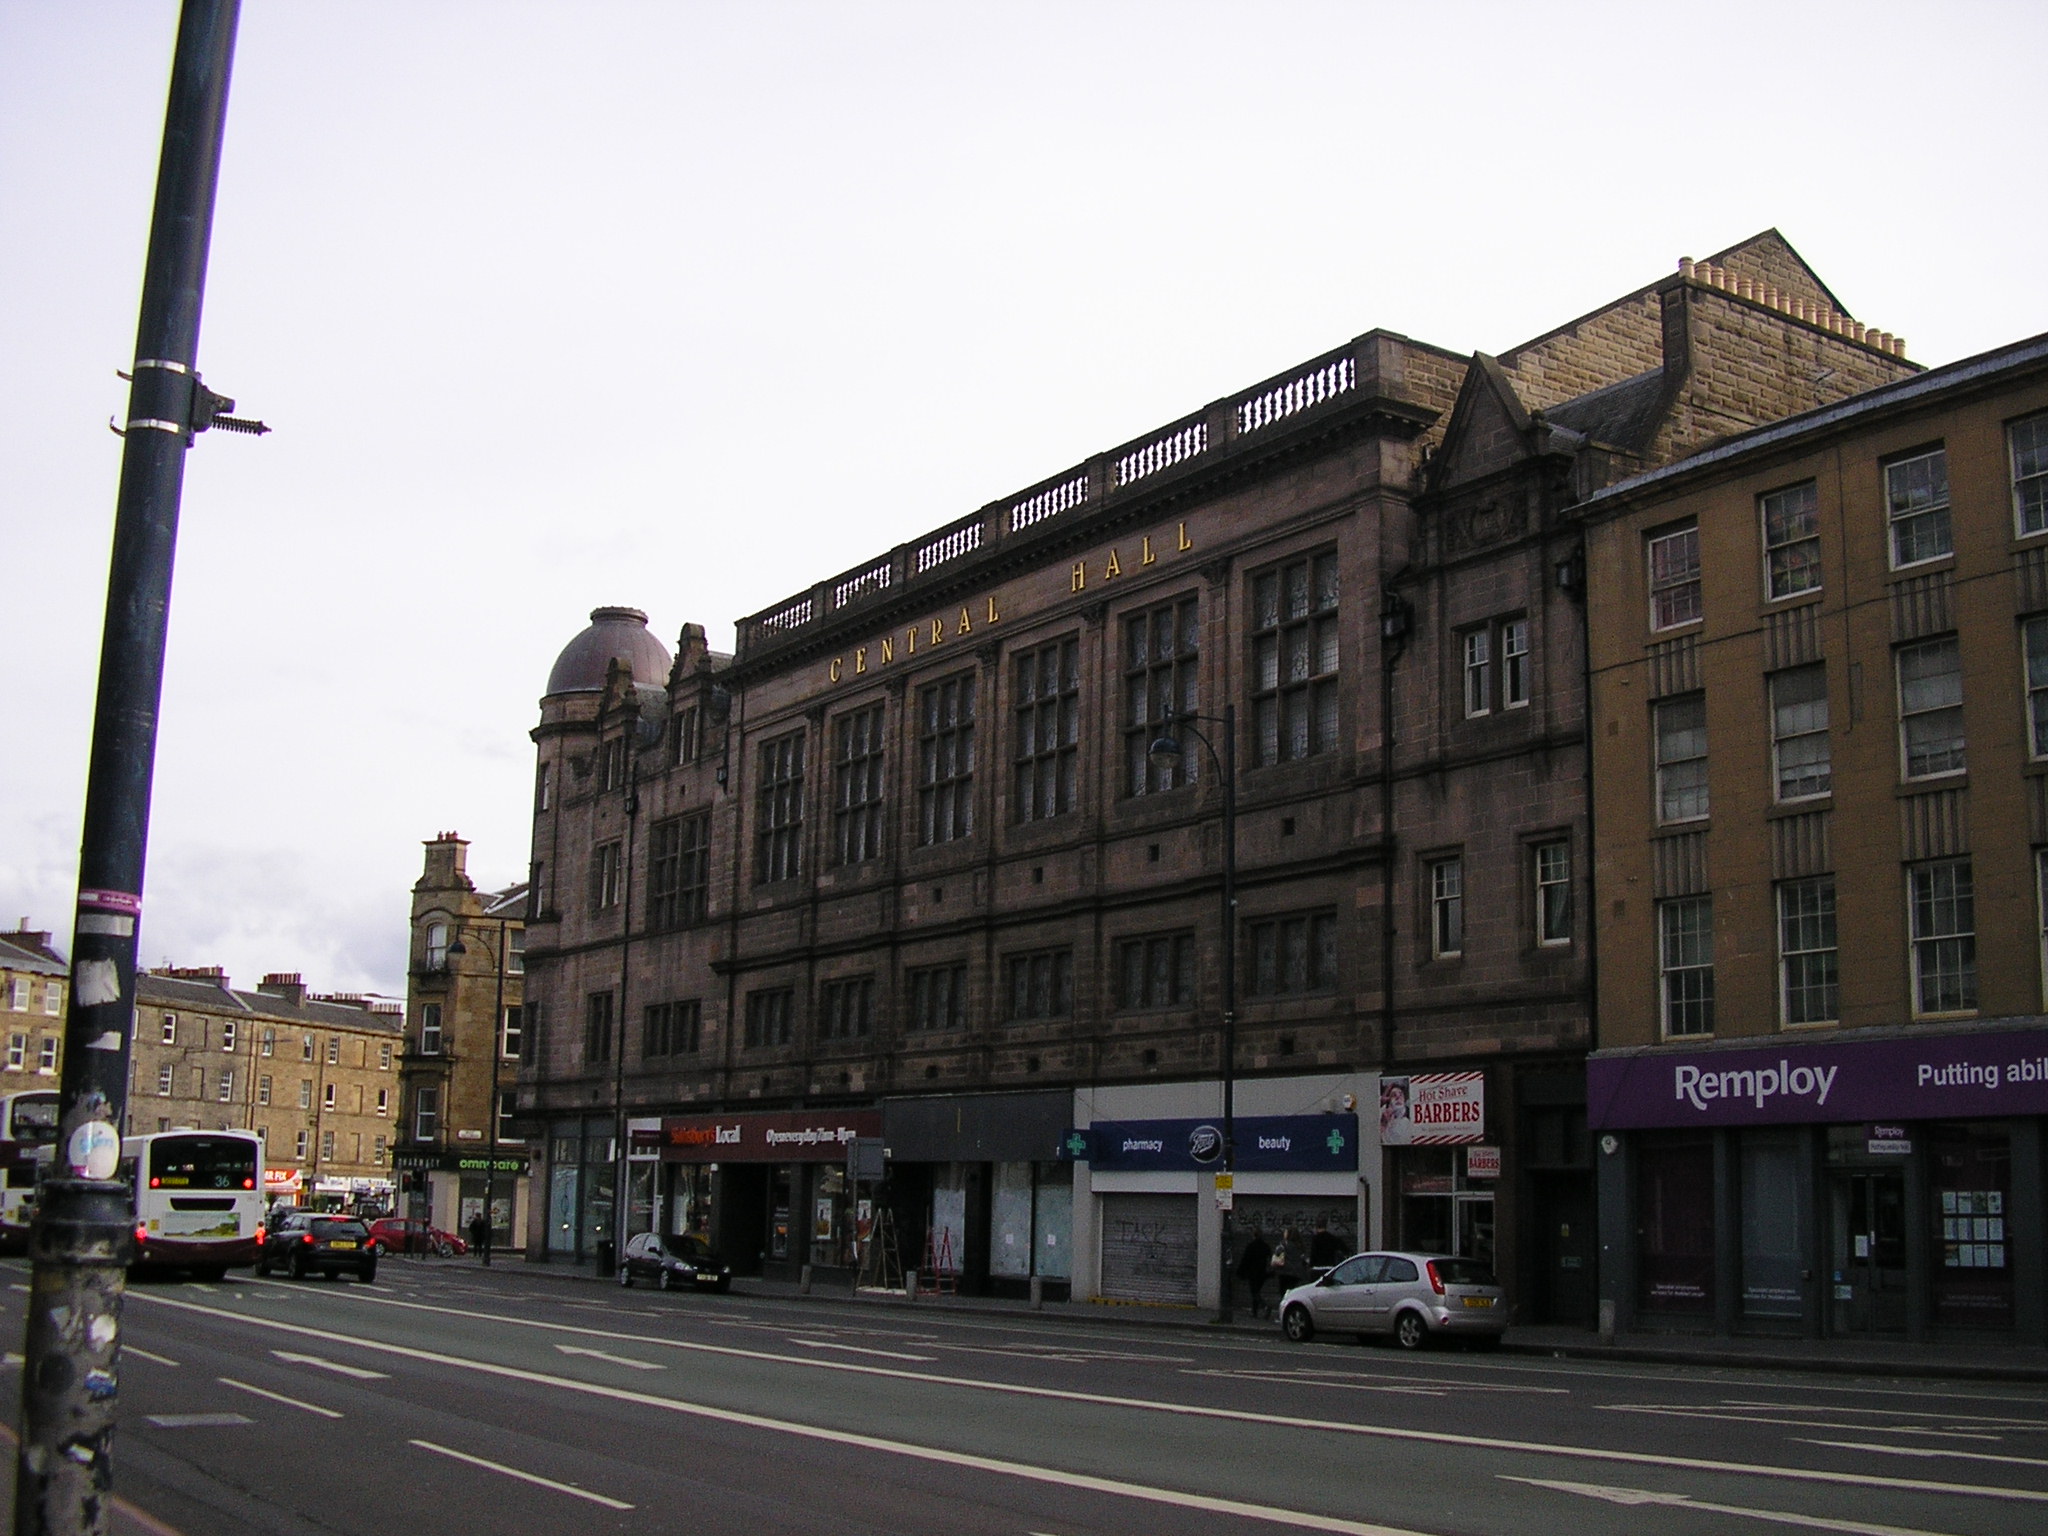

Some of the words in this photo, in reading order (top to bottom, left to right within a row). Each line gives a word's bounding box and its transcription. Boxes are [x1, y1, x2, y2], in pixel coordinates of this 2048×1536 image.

[829, 596, 1000, 682] CENTRAL
[1070, 522, 1193, 593] HALL
[1917, 1061, 1999, 1089] Putting
[1675, 1060, 1838, 1110] Remploy
[1419, 1090, 1436, 1102] Hot
[1438, 1086, 1468, 1100] Shave
[1413, 1101, 1480, 1124] BARBERS
[716, 1124, 741, 1144] Local
[1874, 1125, 1905, 1138] Remploy
[1122, 1138, 1163, 1152] pharmacy
[1258, 1136, 1291, 1151] beauty
[459, 1159, 519, 1170] omnare
[1469, 1157, 1499, 1169] BARBERS
[215, 1175, 230, 1188] 36
